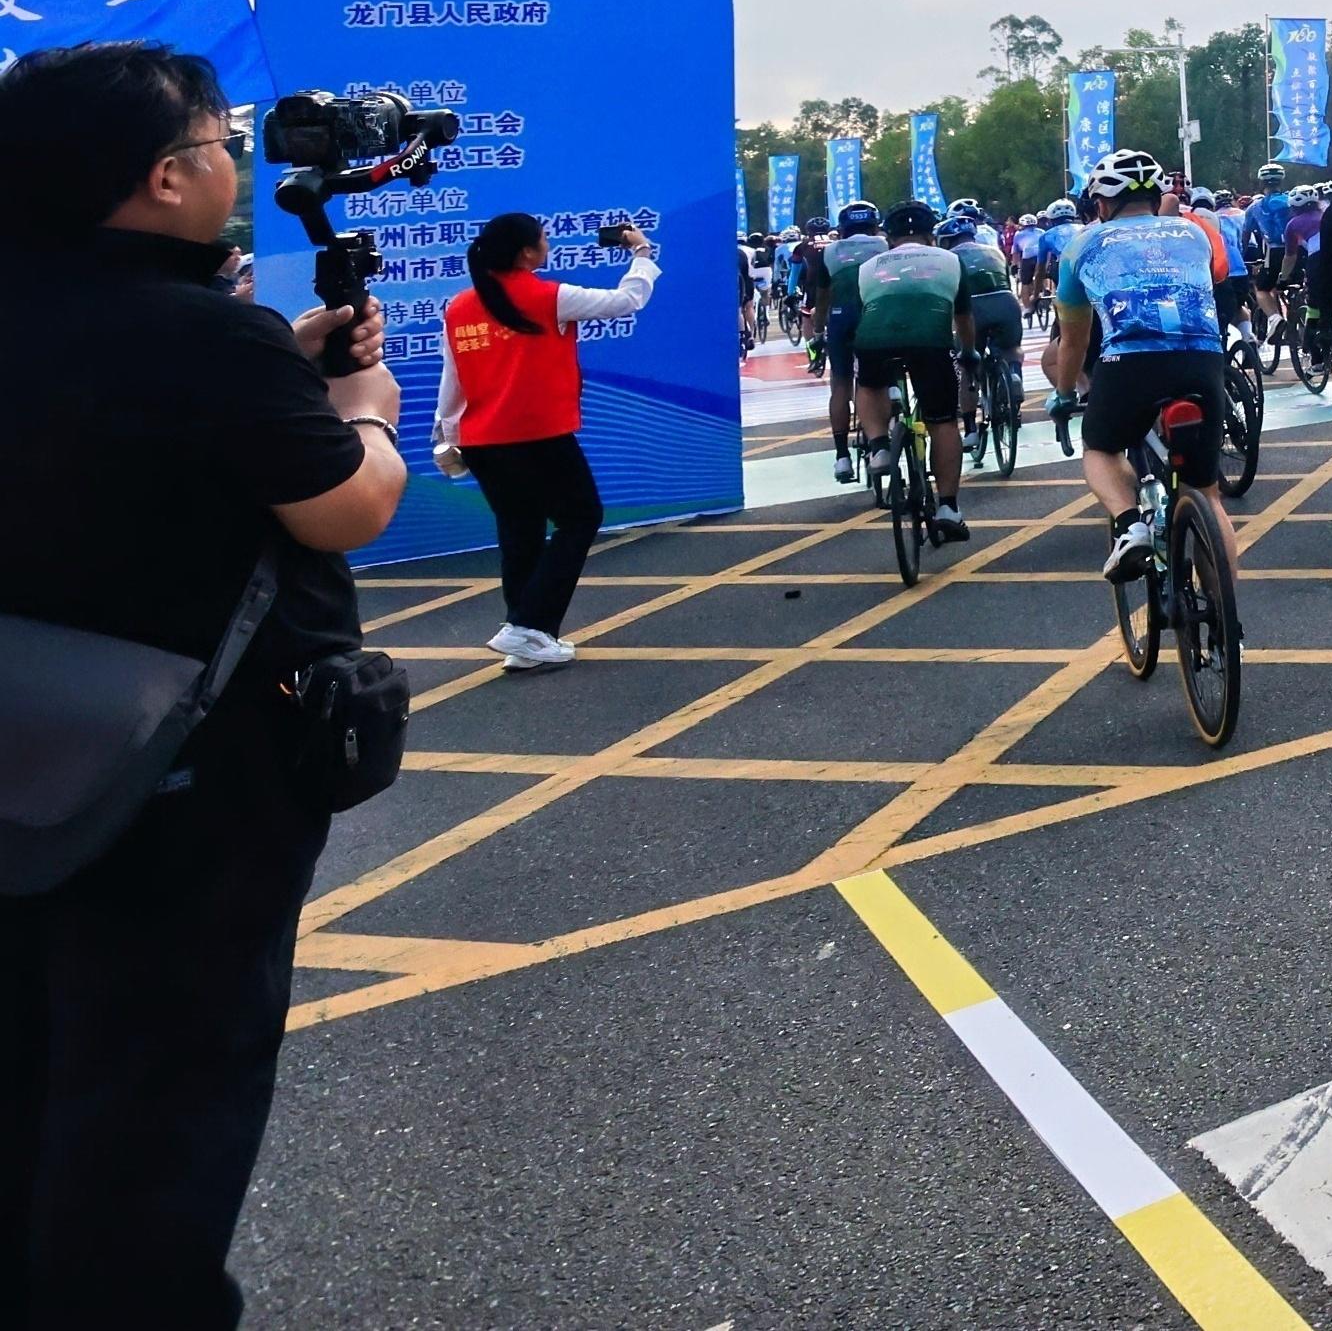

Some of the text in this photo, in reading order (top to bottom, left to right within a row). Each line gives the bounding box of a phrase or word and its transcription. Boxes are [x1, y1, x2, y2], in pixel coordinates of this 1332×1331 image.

[346, 2, 548, 26] 龙门县人民政府
[390, 140, 429, 177] RONIN
[347, 189, 467, 217] 执行单位
